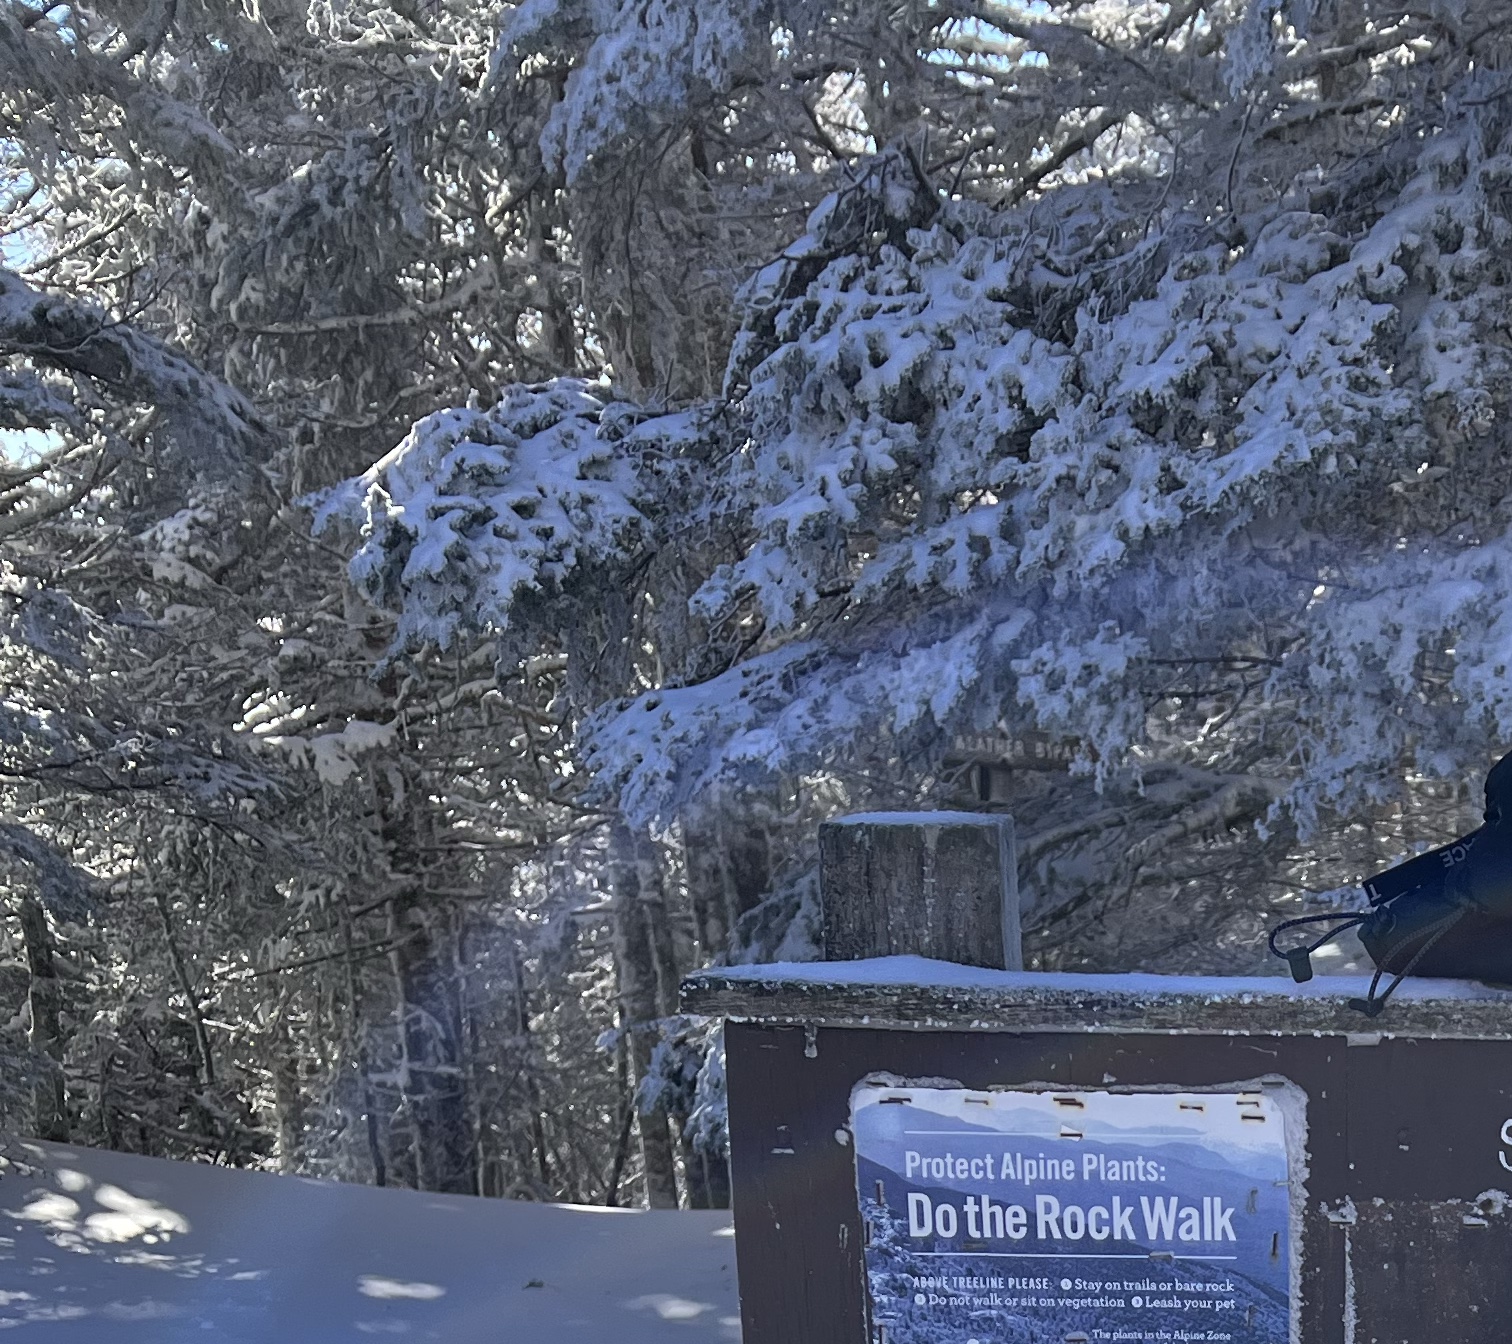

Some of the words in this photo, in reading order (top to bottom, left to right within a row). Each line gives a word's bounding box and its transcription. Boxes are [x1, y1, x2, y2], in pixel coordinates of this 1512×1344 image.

[905, 1151, 995, 1180] Protect
[1001, 1153, 1075, 1185] Alpine
[1083, 1154, 1166, 1182] Plants:
[908, 1192, 957, 1238] Do
[964, 1195, 1027, 1239] the
[1036, 1194, 1136, 1240] Rock
[1140, 1196, 1237, 1241] Walk
[913, 1277, 948, 1288] ABOVE
[952, 1277, 1004, 1289] TREELINE
[1008, 1277, 1052, 1289] PLEASE:
[1074, 1278, 1102, 1293] Stay
[1105, 1281, 1121, 1290] on
[1124, 1278, 1156, 1291] trails
[1159, 1281, 1173, 1291] or
[1175, 1278, 1203, 1292] bare
[1206, 1279, 1235, 1292] rock
[929, 1294, 946, 1305] Do
[949, 1295, 970, 1305] not
[973, 1293, 1003, 1305] walk
[1005, 1297, 1018, 1306] or
[1021, 1295, 1036, 1306] sit
[1039, 1297, 1056, 1306] on
[1057, 1296, 1125, 1310] vegetation
[1146, 1296, 1182, 1308] Leash
[1184, 1299, 1212, 1311] your
[1215, 1299, 1235, 1311] pet
[1092, 1328, 1111, 1339] The
[1112, 1329, 1142, 1340] plants
[1144, 1330, 1154, 1339] in
[1156, 1329, 1171, 1339] the
[1173, 1330, 1205, 1342] Alpine
[1207, 1330, 1231, 1340] Zone
